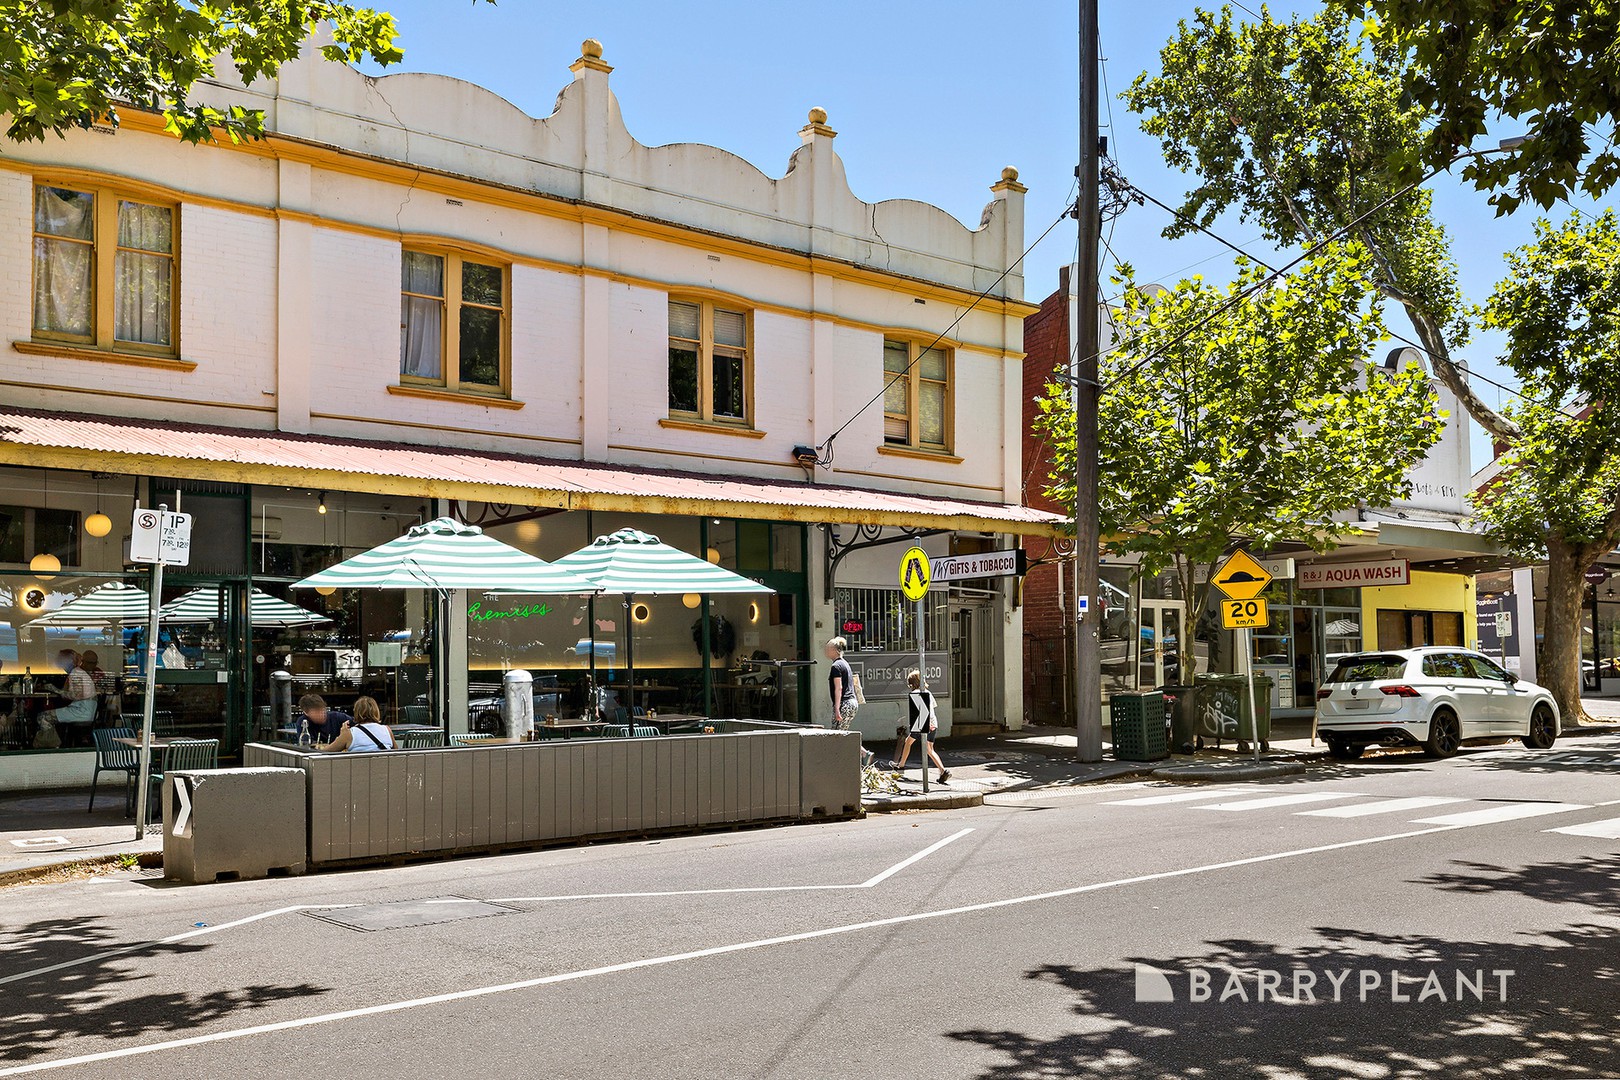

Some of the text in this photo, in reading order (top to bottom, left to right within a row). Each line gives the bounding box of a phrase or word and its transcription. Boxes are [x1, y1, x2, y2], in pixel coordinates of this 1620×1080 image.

[170, 515, 185, 528] 1P
[949, 561, 969, 575] GIFTS
[972, 561, 977, 573] &
[980, 557, 1014, 572] TOBACCO
[1326, 568, 1361, 582] AQUA
[1363, 566, 1401, 580] WASH
[835, 591, 850, 602] 198
[1231, 601, 1258, 618] 20
[843, 623, 863, 631] OPEN
[1235, 618, 1255, 626] km/h
[866, 668, 892, 680] GIFTS
[895, 667, 901, 680] &
